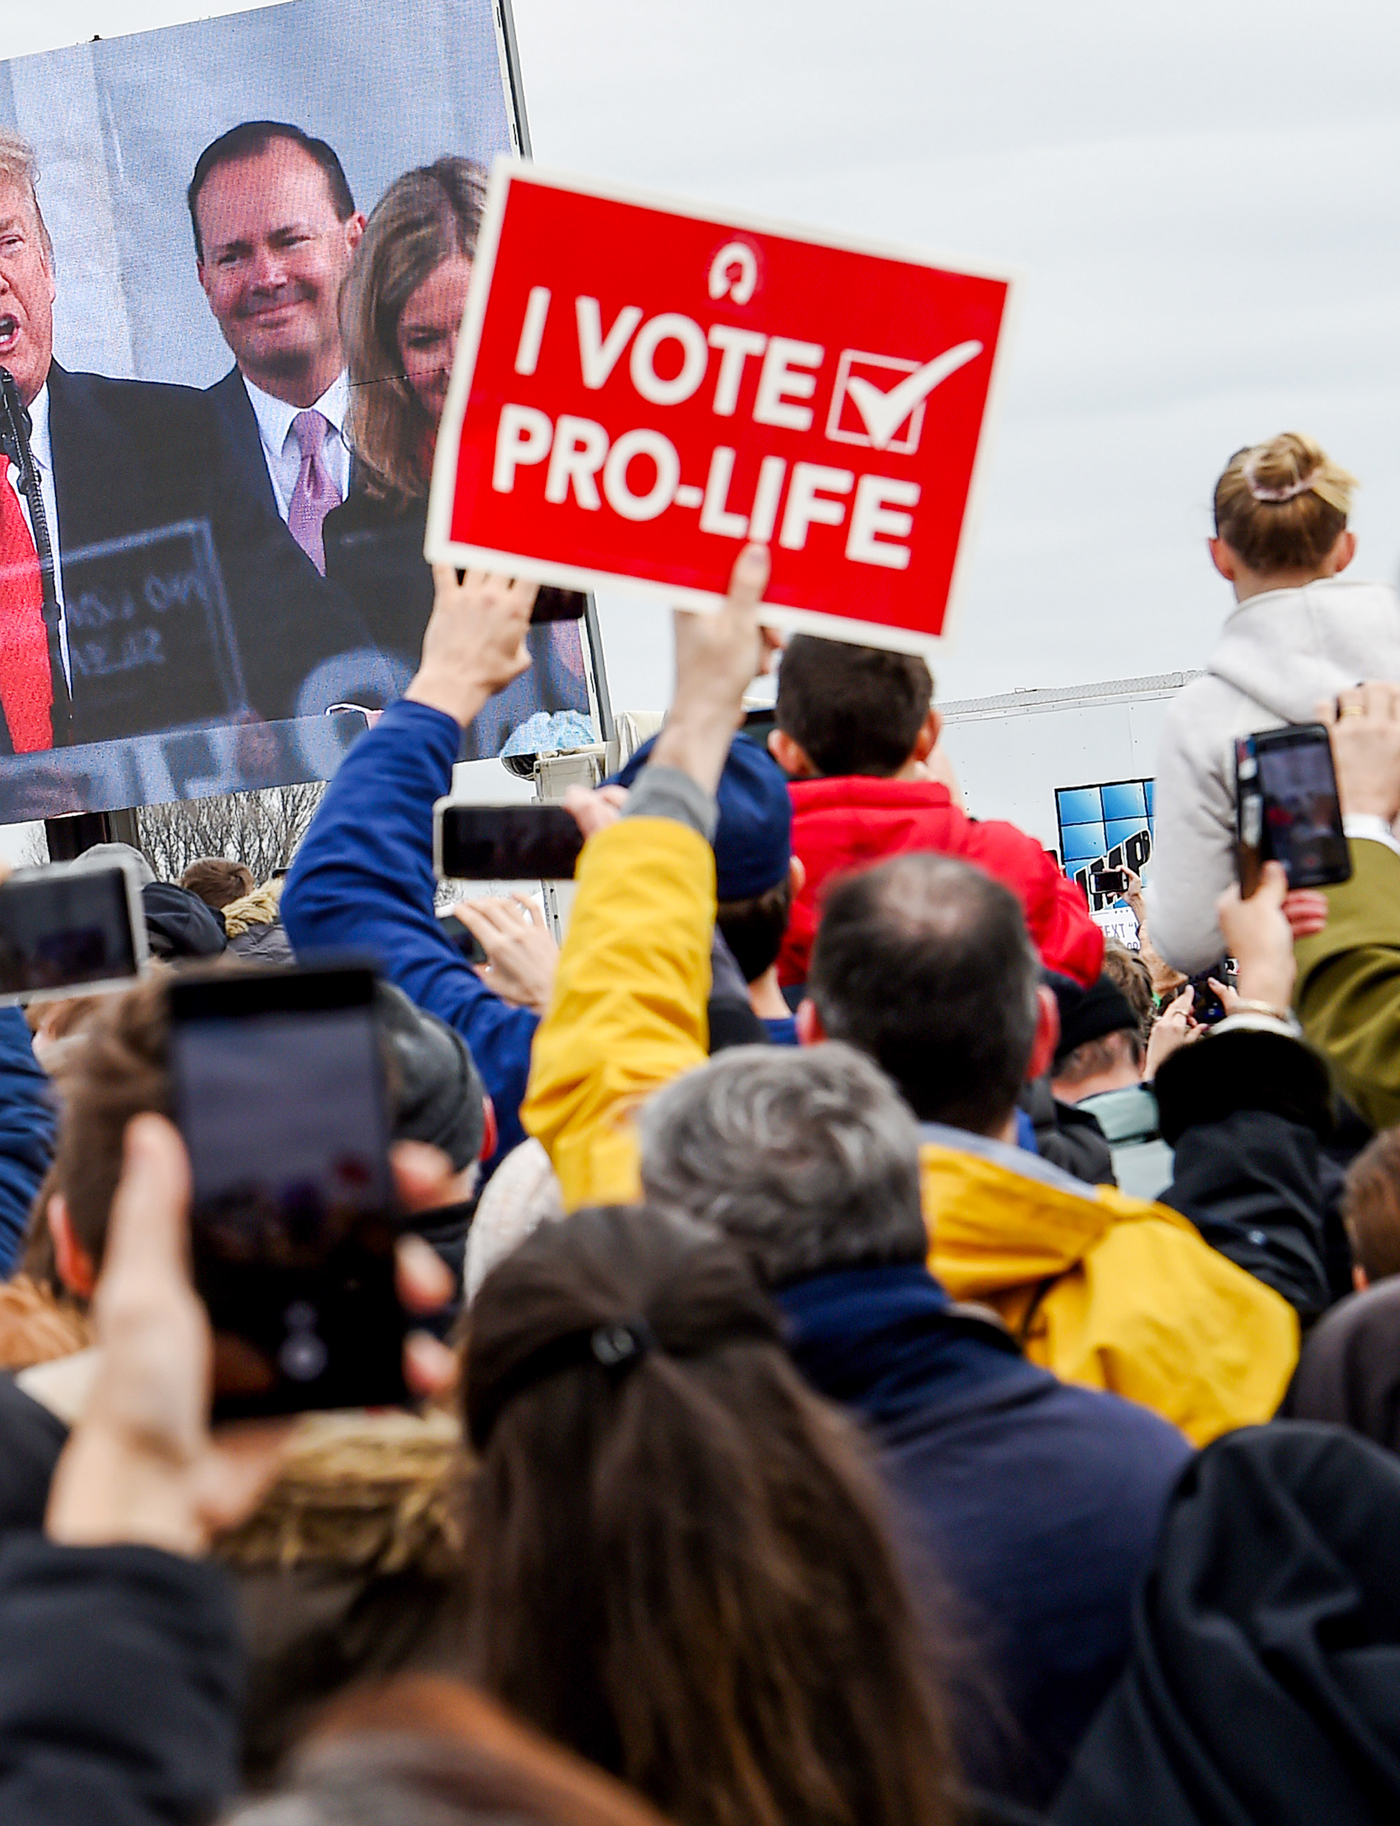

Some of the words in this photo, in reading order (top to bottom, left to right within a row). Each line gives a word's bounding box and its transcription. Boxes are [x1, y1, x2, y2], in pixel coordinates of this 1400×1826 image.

[514, 286, 551, 375] I
[575, 296, 824, 431] VOTE
[492, 403, 921, 570] PRO-LIFE
